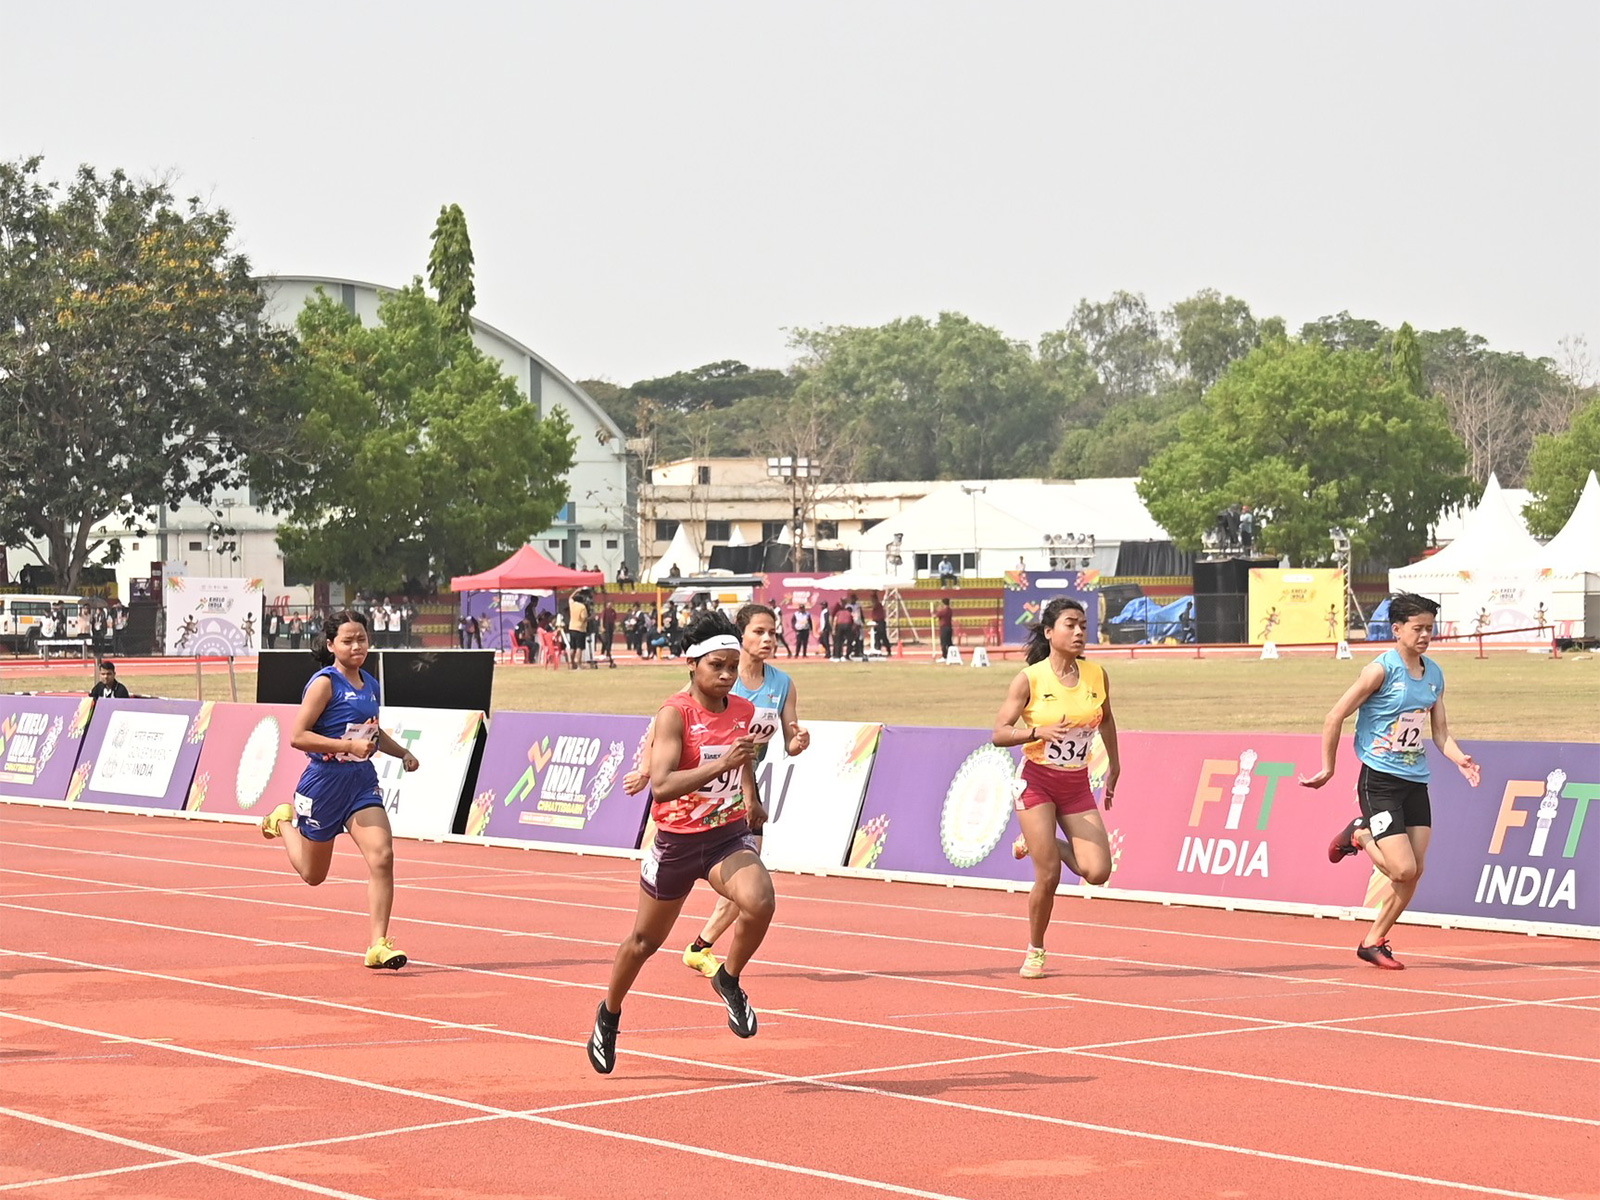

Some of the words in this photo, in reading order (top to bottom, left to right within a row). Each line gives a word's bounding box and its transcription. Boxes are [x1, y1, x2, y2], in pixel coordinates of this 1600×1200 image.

[551, 736, 601, 766] KHELO
[1048, 740, 1089, 761] 534
[542, 764, 586, 794] INDIA
[1188, 749, 1296, 831] FIT
[1487, 768, 1600, 858] FIT
[1176, 836, 1269, 878] INDIA
[1474, 864, 1576, 910] INDIA
